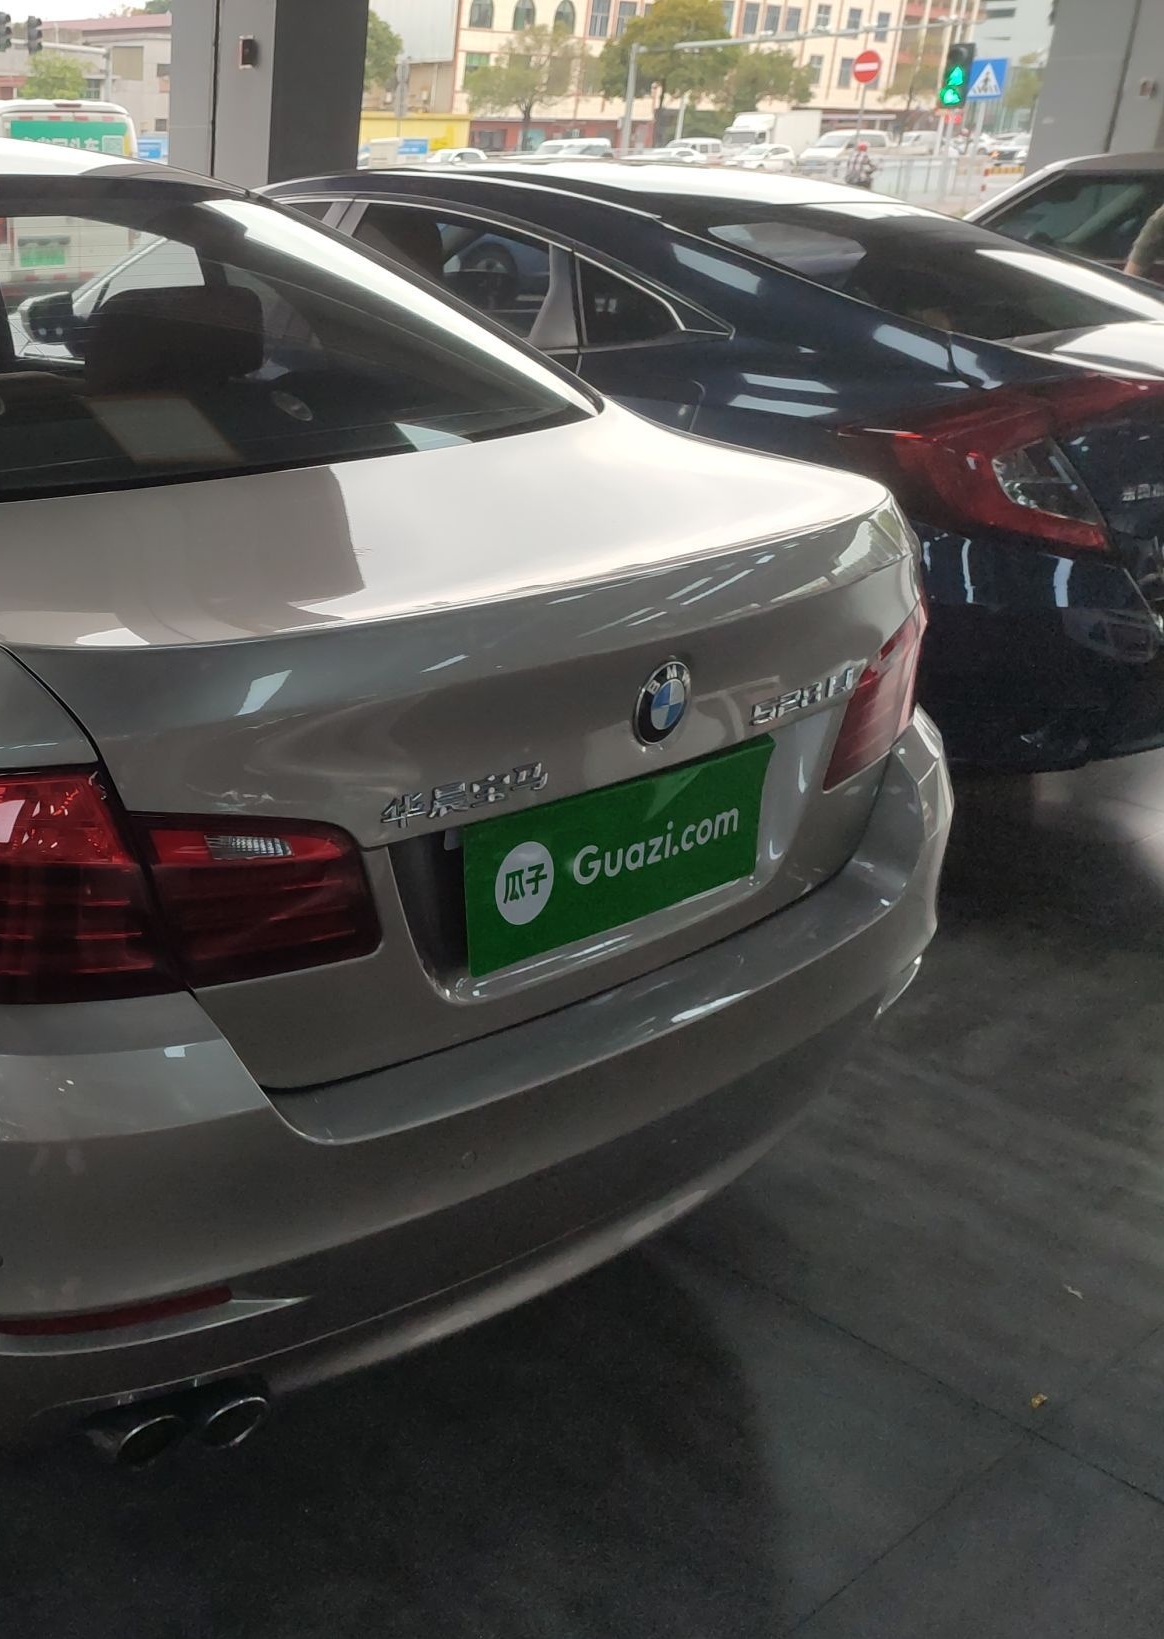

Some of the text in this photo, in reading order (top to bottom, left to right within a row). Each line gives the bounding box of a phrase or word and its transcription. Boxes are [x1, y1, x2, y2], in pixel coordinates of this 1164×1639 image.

[380, 761, 549, 828] 华晨宝马
[573, 807, 739, 885] Guazi.com
[503, 862, 548, 904] 瓜子
